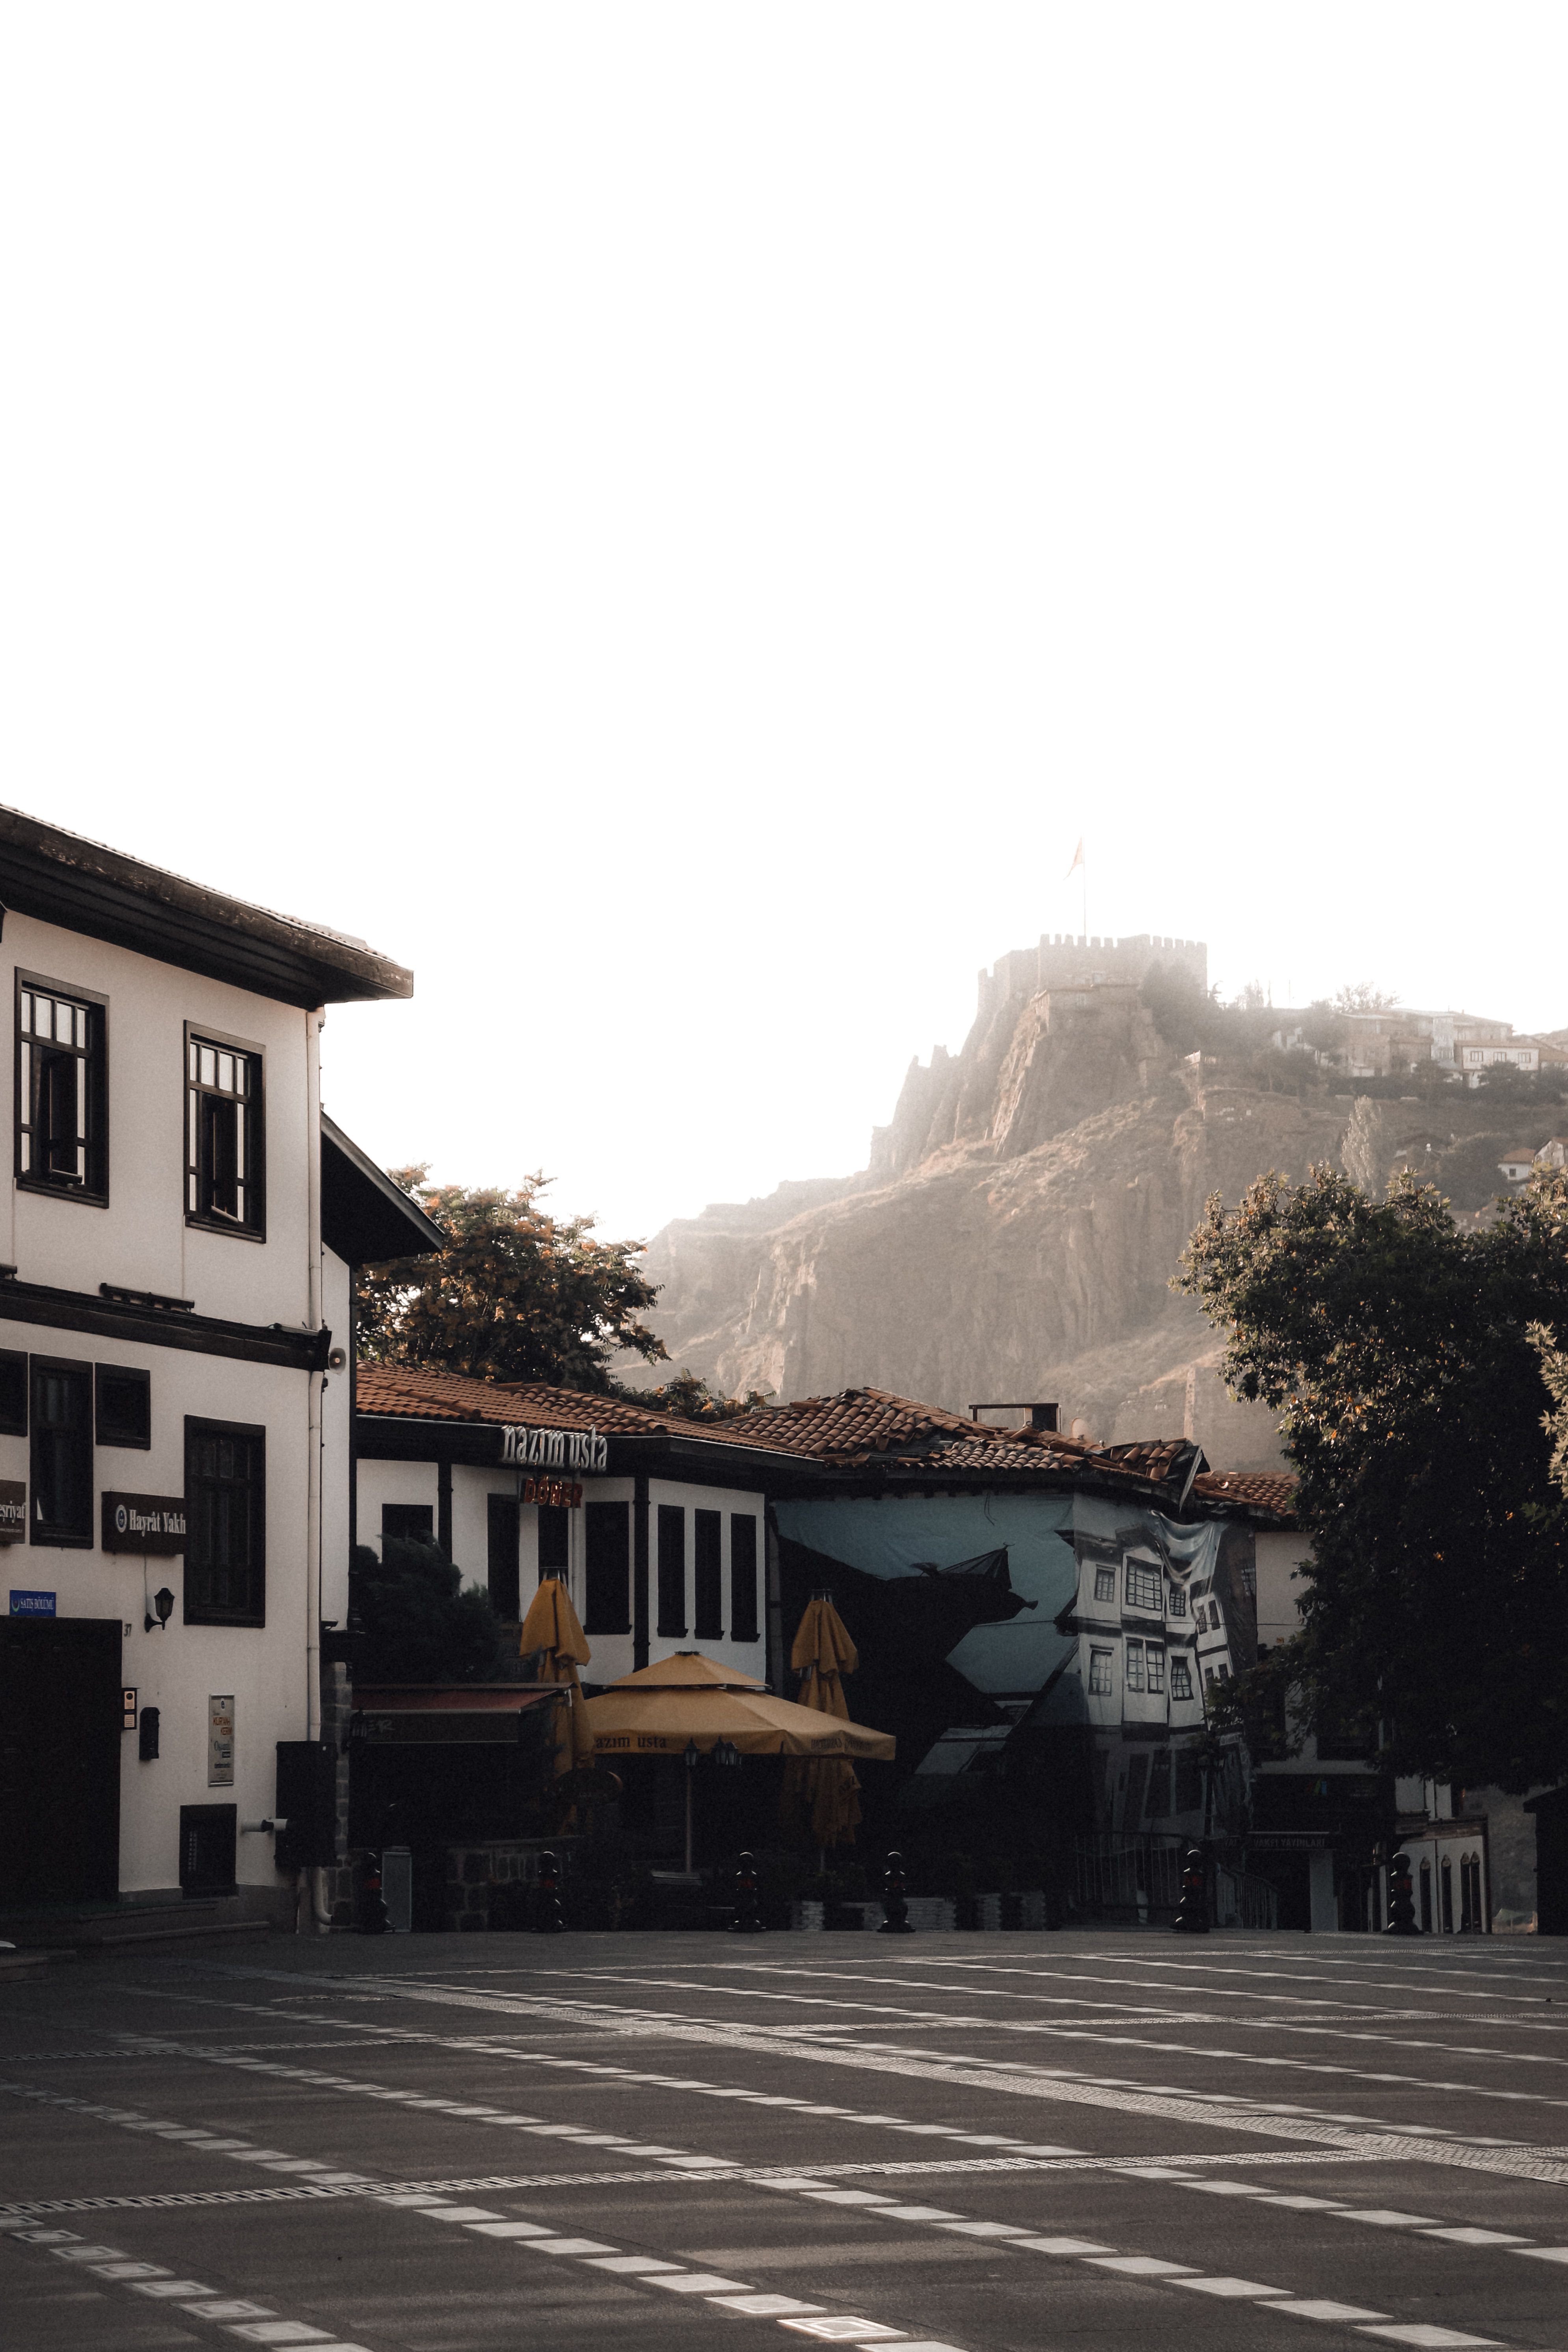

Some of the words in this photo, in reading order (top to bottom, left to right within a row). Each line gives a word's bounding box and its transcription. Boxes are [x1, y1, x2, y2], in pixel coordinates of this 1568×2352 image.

[569, 1424, 607, 1472] usta
[524, 1473, 583, 1508] DÖNER
[124, 1624, 132, 1637] 37
[637, 1736, 667, 1748] usta
